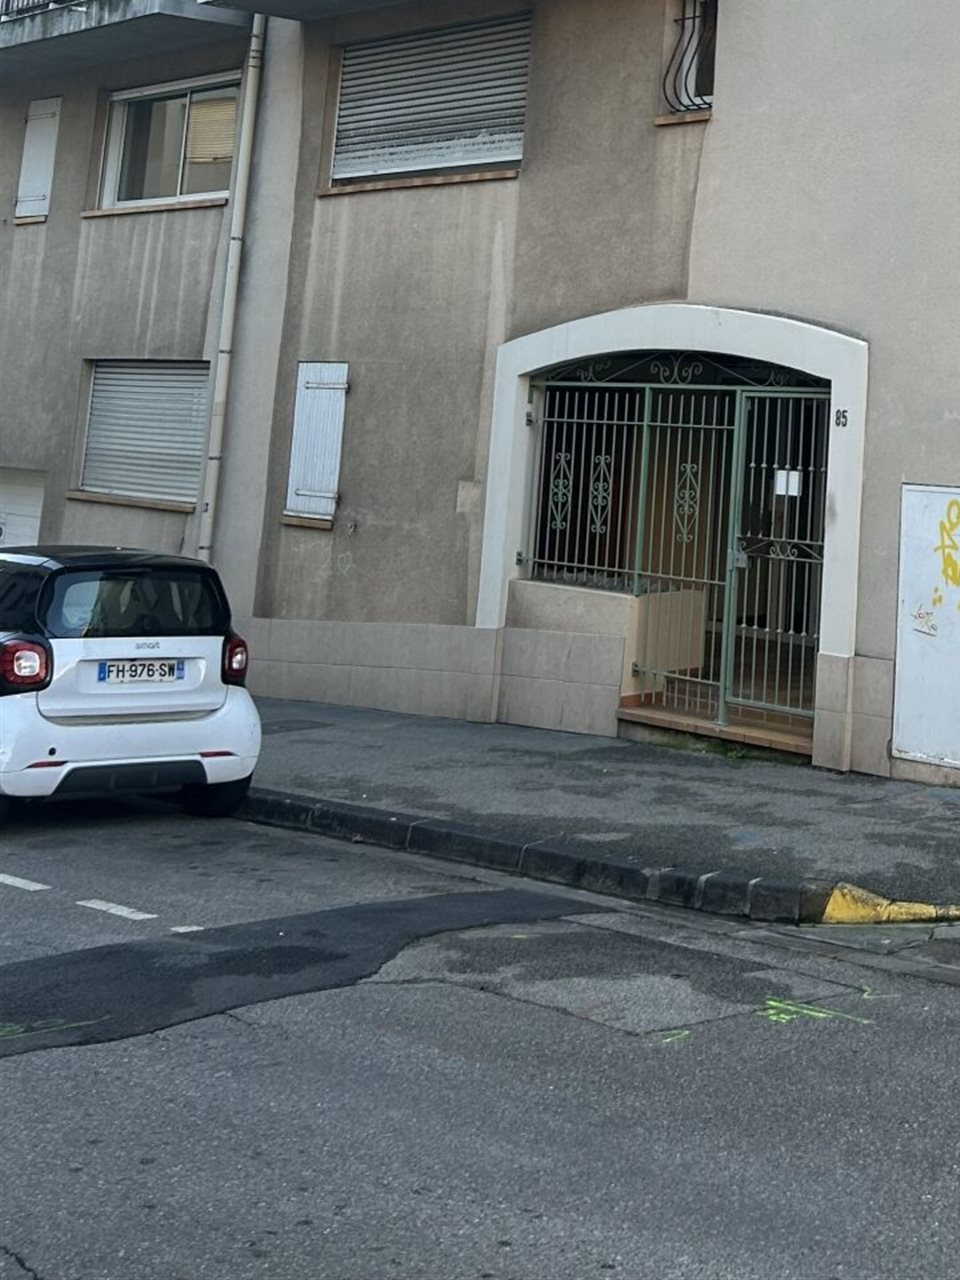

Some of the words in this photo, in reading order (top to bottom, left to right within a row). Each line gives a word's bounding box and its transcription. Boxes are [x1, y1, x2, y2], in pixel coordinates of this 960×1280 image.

[835, 409, 848, 427] 85
[135, 641, 160, 650] smart
[107, 663, 175, 678] FH-976-SW
